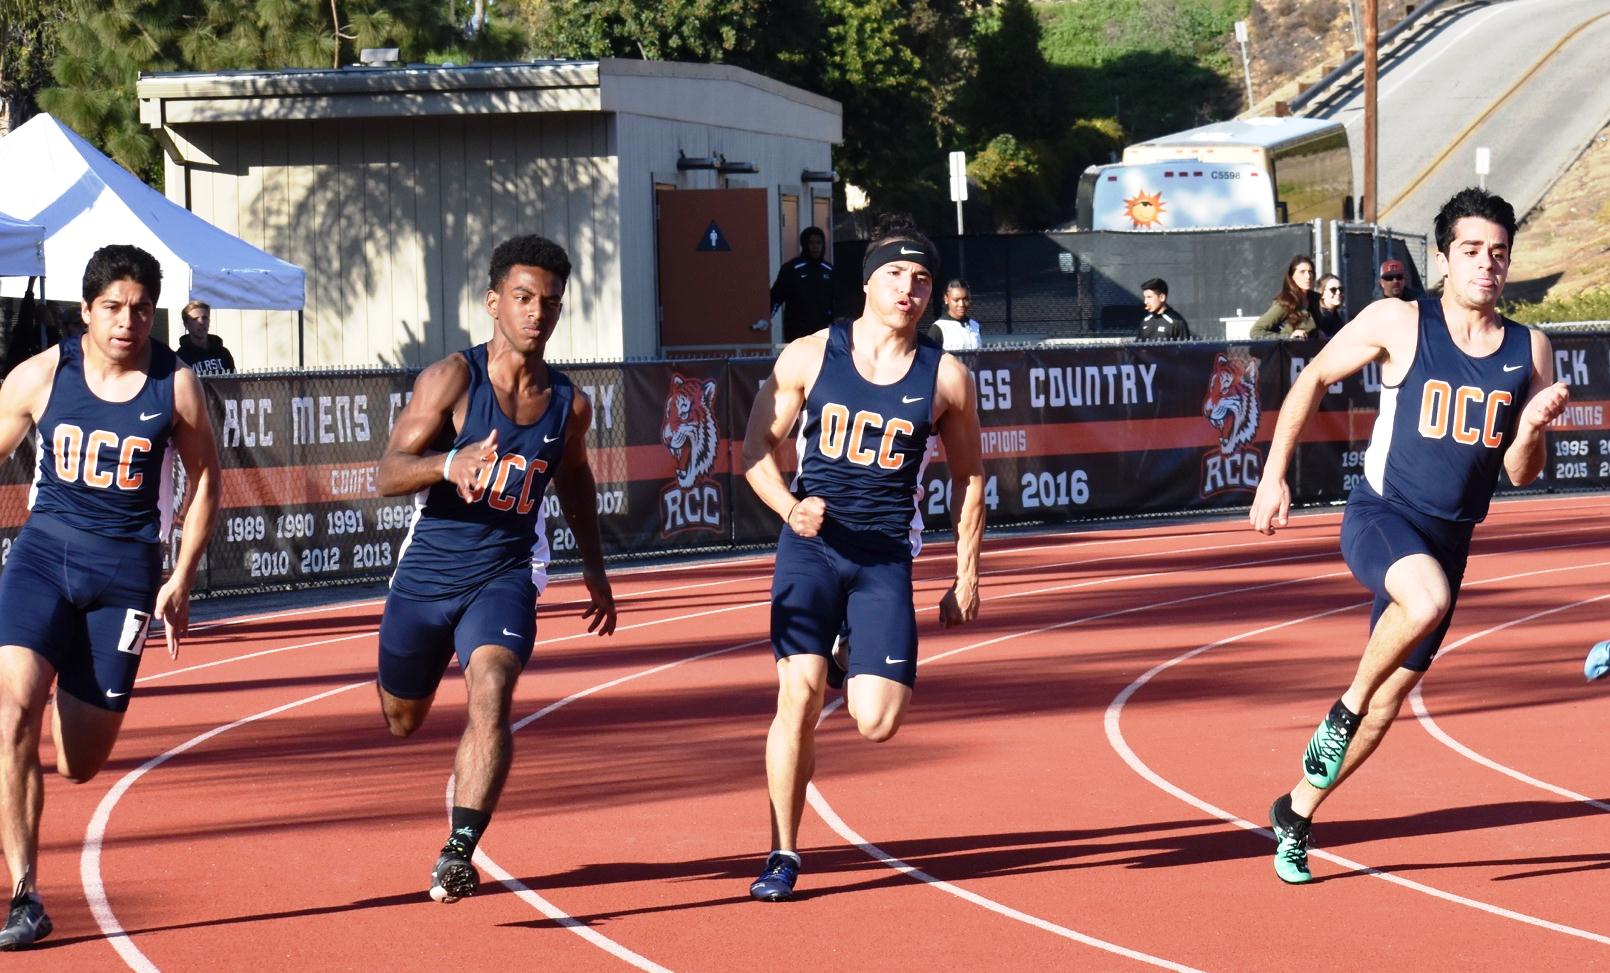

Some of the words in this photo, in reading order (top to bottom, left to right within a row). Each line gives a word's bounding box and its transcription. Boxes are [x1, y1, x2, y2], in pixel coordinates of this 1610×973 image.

[1029, 364, 1157, 408] COUNTRY
[291, 394, 371, 446] MENS
[1418, 379, 1512, 448] OCC
[819, 402, 915, 470] OCC
[1555, 440, 1589, 457] 1995
[53, 423, 152, 490] OCC
[1204, 453, 1260, 492] RCC
[1556, 462, 1588, 479] 2015
[331, 467, 379, 496] CONFE
[1021, 469, 1090, 508] 2016
[226, 515, 265, 542] 1989
[276, 512, 315, 539] 1990
[327, 509, 365, 536] 1991
[376, 504, 414, 531] 1992
[664, 486, 720, 531] RCC
[251, 550, 290, 577] 2010
[301, 546, 341, 574] 2012
[353, 541, 392, 569] 2013
[127, 613, 150, 651] 7
